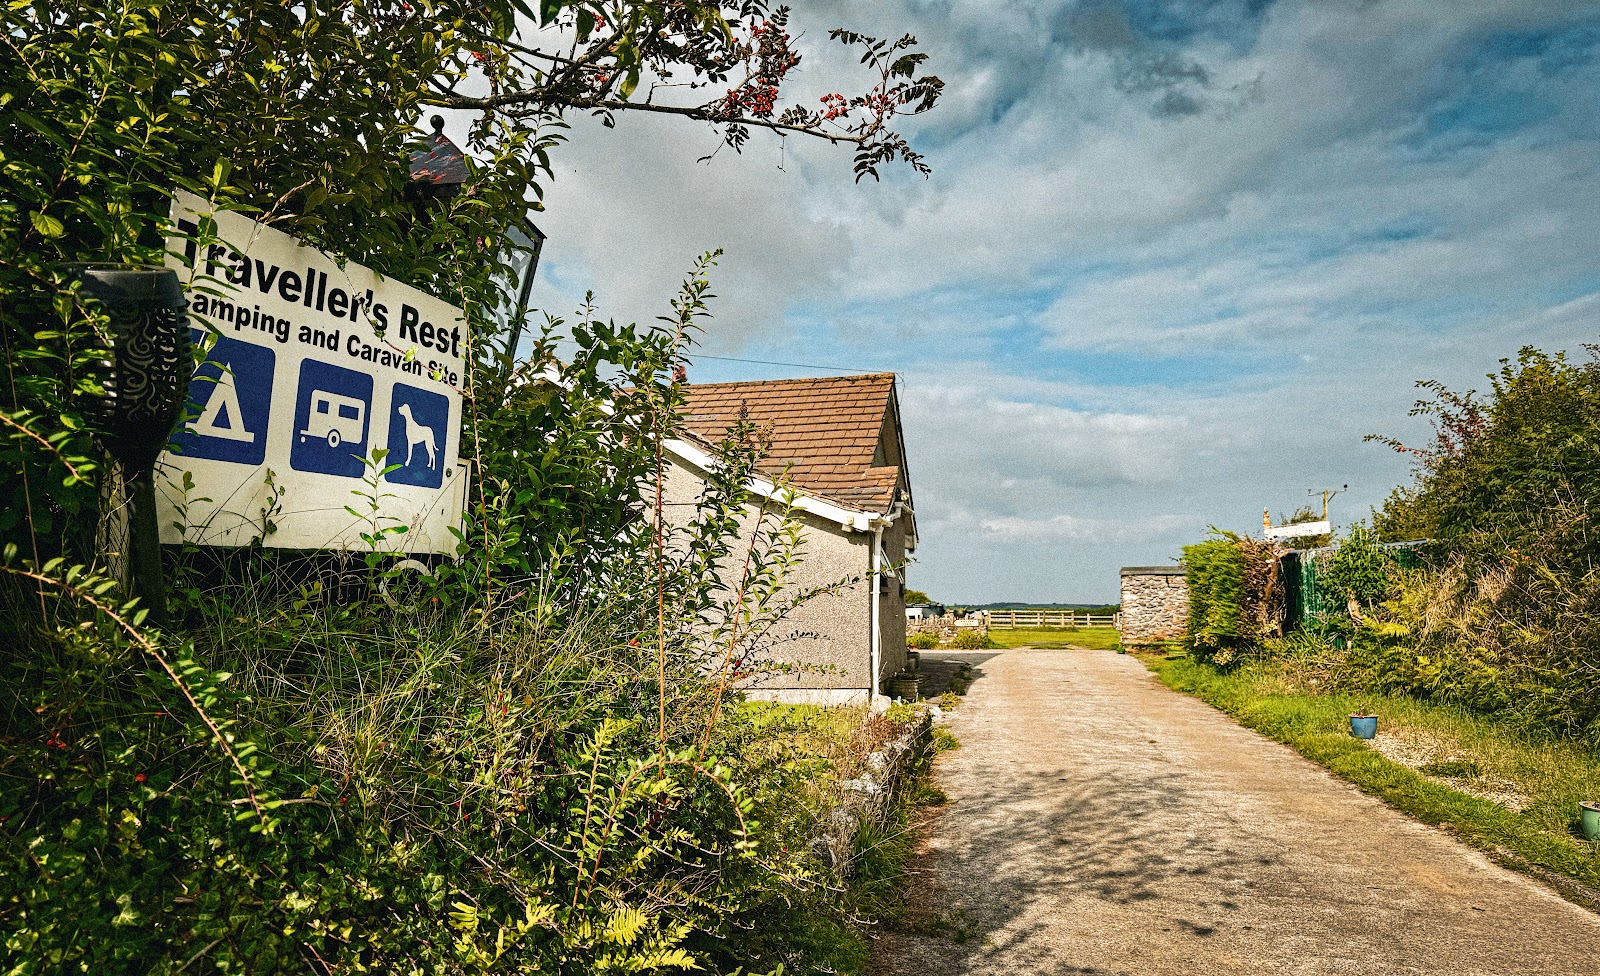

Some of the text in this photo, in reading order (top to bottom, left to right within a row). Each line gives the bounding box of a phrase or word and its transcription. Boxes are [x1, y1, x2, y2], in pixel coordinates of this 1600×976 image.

[177, 218, 461, 358] Traveller's Rest
[298, 325, 340, 352] and
[346, 334, 422, 376] Caravan
